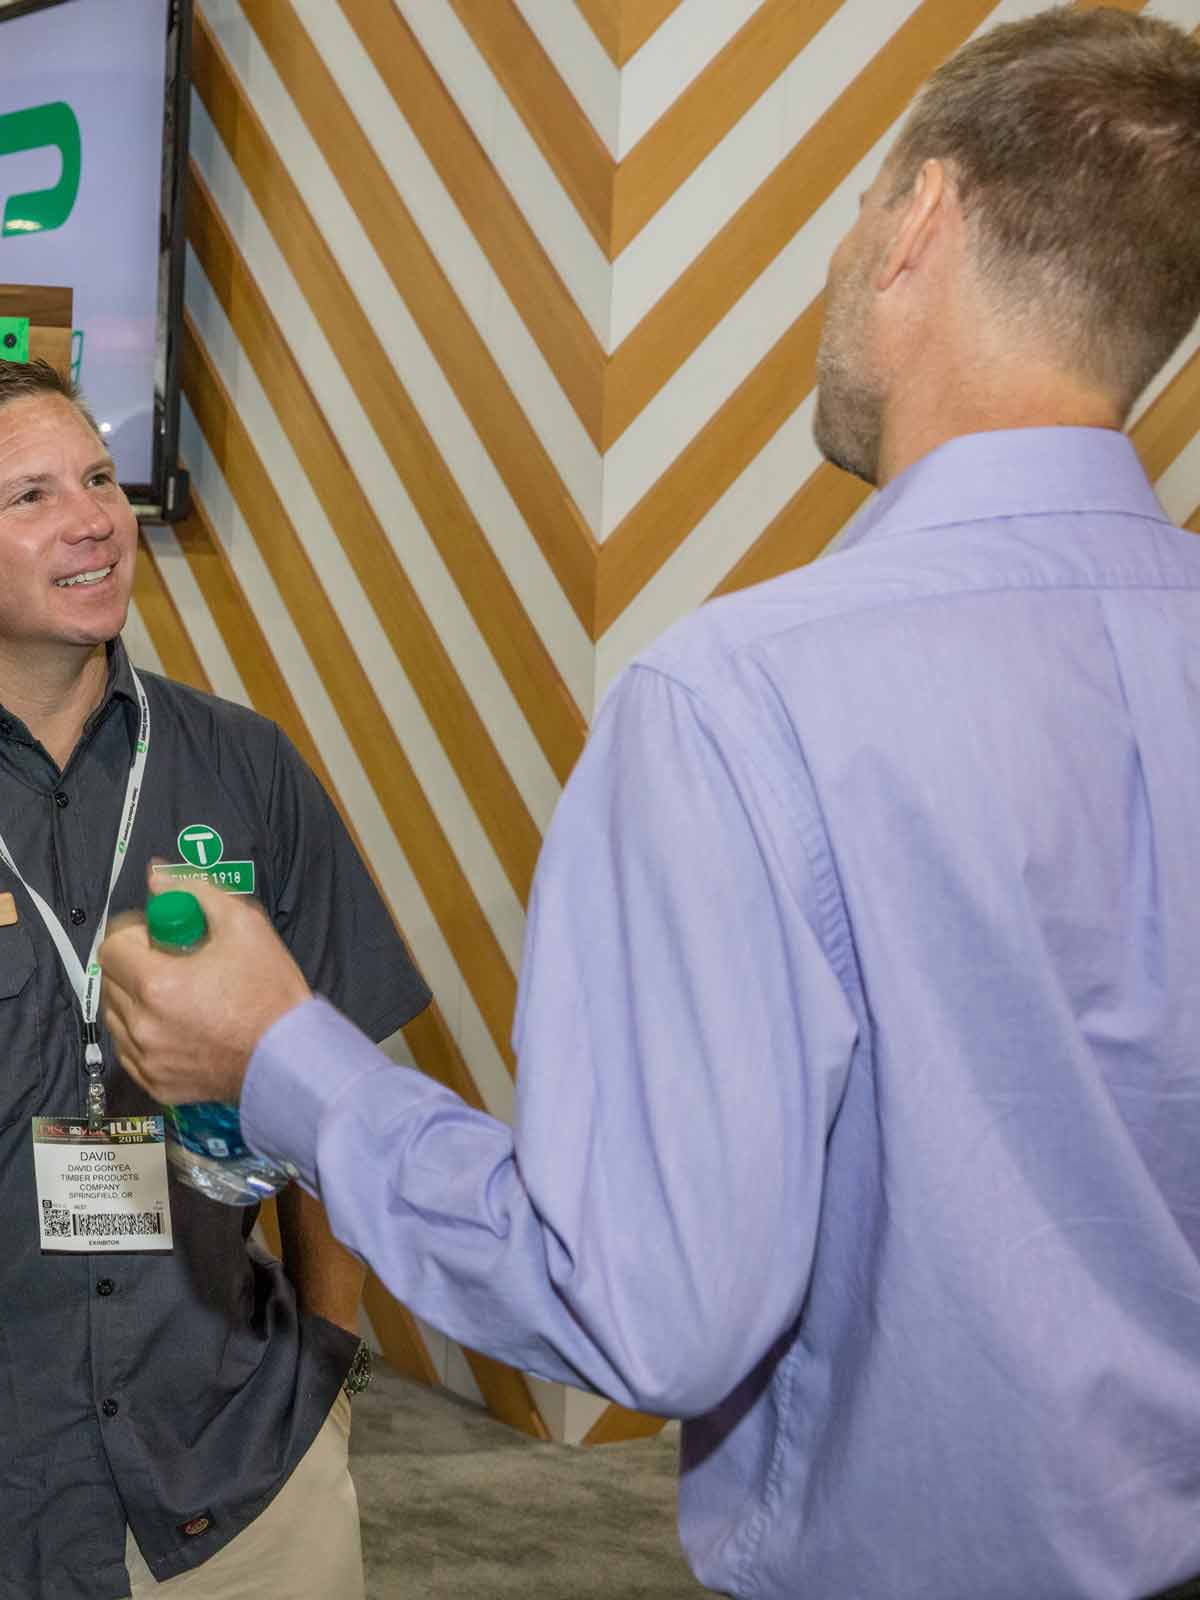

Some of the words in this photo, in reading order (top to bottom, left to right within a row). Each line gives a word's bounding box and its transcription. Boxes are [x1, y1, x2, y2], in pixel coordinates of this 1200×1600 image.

[183, 832, 214, 865] T
[212, 871, 241, 884] 1918
[80, 1151, 116, 1161] DAVID
[67, 1164, 92, 1172] DAVID
[94, 1164, 131, 1172] GONYEA
[61, 1174, 90, 1182] TIMBER
[93, 1173, 139, 1182] PRODUCTS
